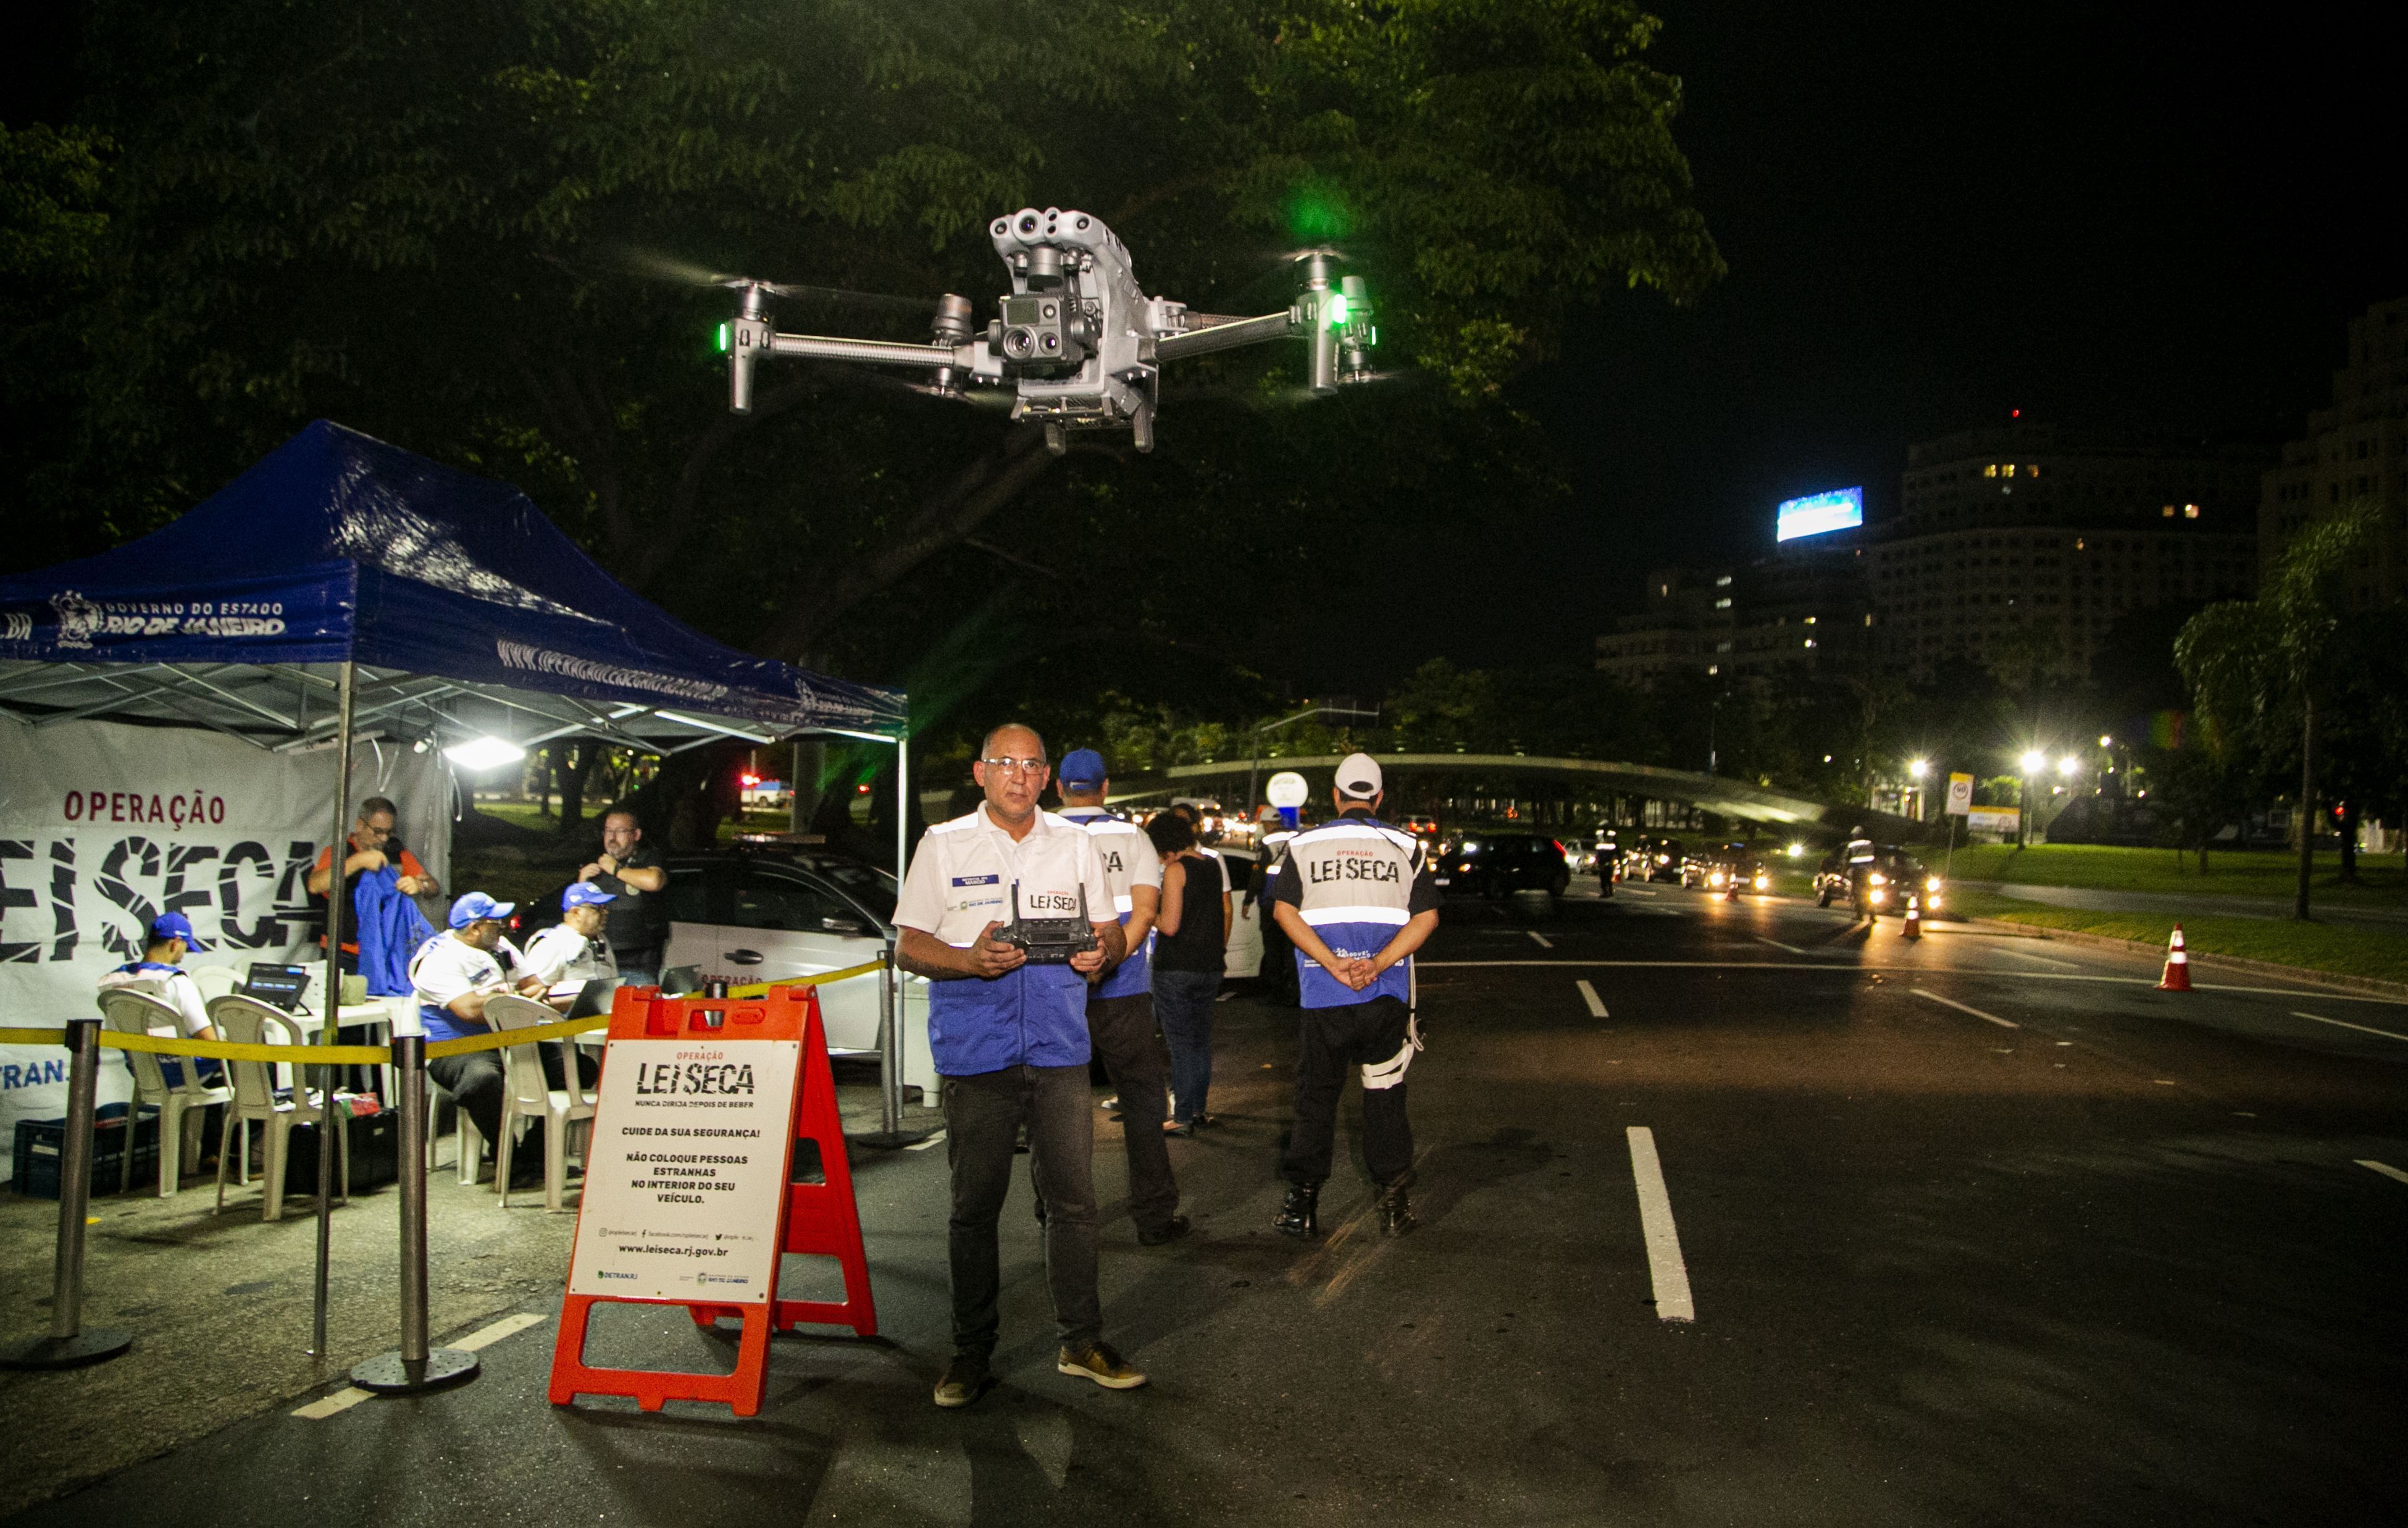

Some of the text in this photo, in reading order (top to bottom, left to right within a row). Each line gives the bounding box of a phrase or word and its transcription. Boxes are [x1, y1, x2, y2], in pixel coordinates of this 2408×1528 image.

[106, 603, 283, 615] GOVERNO DO ESTADO
[102, 616, 145, 635] RIO
[64, 790, 225, 831] OPERAÇÃO
[1310, 857, 1399, 884] LEI SECA
[1031, 895, 1077, 911] LEI SECA
[677, 1051, 724, 1062] OPERAÇÃO
[637, 1062, 755, 1095] LEI SECA
[622, 1127, 760, 1140] CUIDE DA SUA SEGURANÇA!
[626, 1151, 748, 1164] NÃO COLOQUE PESSOAS
[653, 1167, 716, 1177] ESTRANHAS
[631, 1180, 735, 1191] NO INTERIOR DO SEU
[657, 1192, 704, 1204] VEÍCULO.
[619, 1245, 729, 1257] www.leiseca.rj.gov.br
